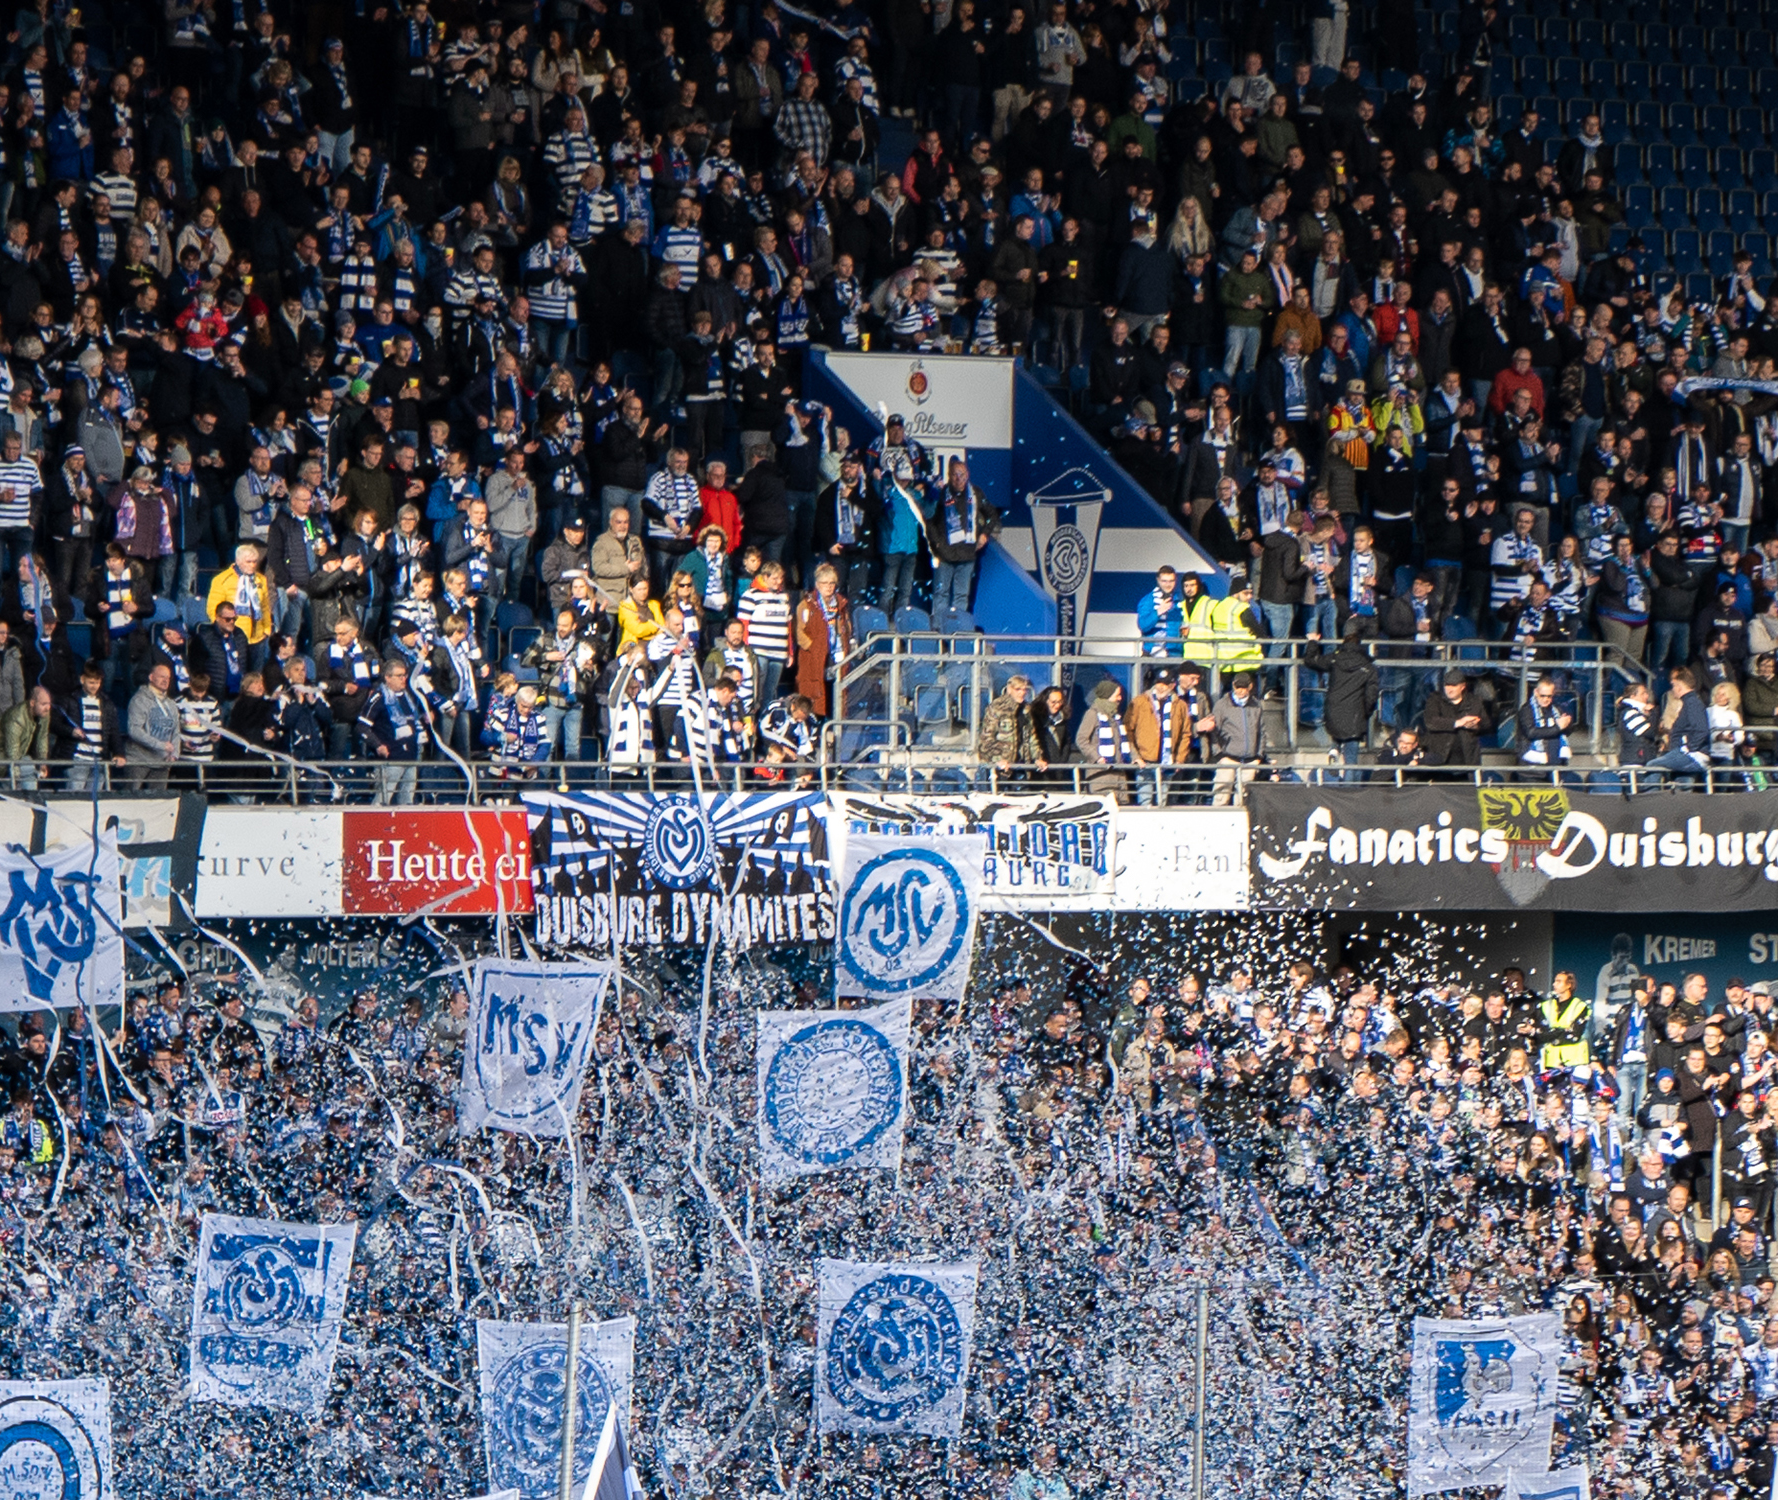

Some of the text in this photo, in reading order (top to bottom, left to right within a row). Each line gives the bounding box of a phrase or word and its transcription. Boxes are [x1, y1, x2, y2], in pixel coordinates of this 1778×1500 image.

[913, 411, 968, 436] Pilsener
[366, 839, 532, 883] Heute ei
[534, 891, 837, 946] DUISBURG DYNAMITES
[854, 868, 949, 958] MSV
[885, 957, 902, 973] 02
[1643, 933, 1717, 966] KREMER
